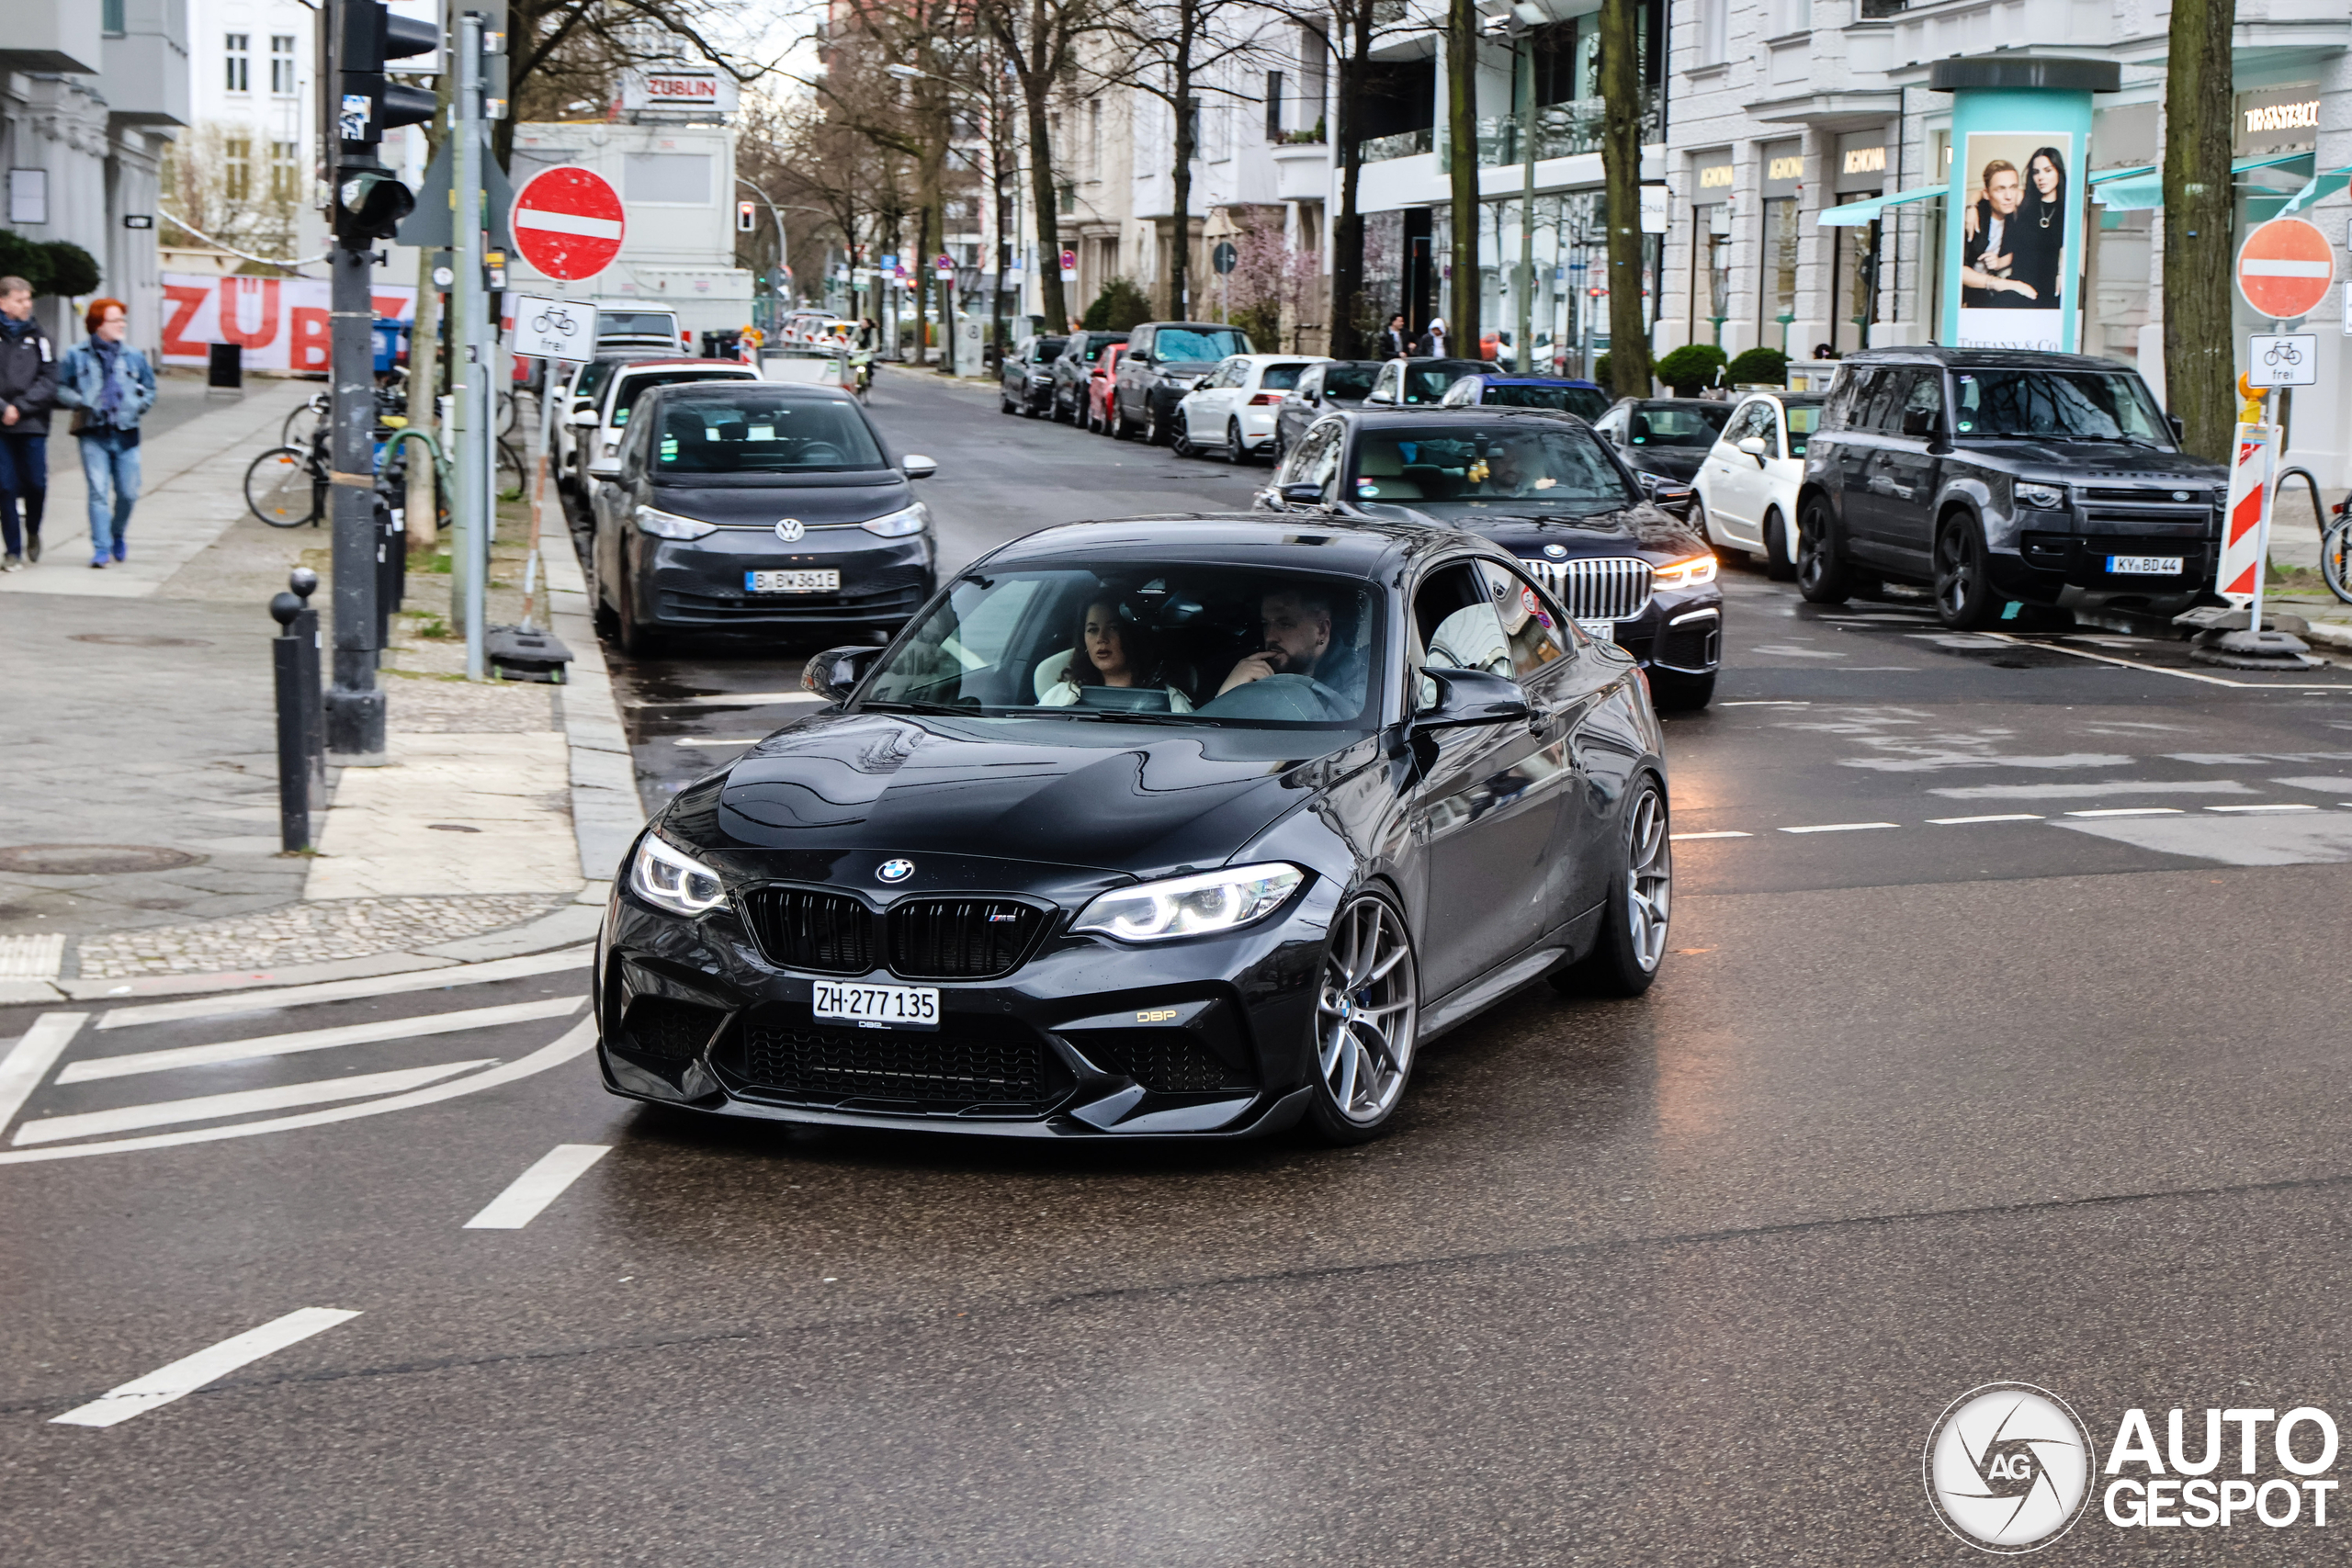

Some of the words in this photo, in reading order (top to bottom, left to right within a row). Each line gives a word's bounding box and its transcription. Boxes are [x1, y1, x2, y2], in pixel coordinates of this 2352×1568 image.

[540, 337, 566, 352] frei
[2272, 368, 2294, 379] frei
[2118, 558, 2135, 570] KY
[2143, 558, 2159, 571] BD
[2162, 559, 2177, 571] 44
[1136, 1010, 1177, 1022] DBP
